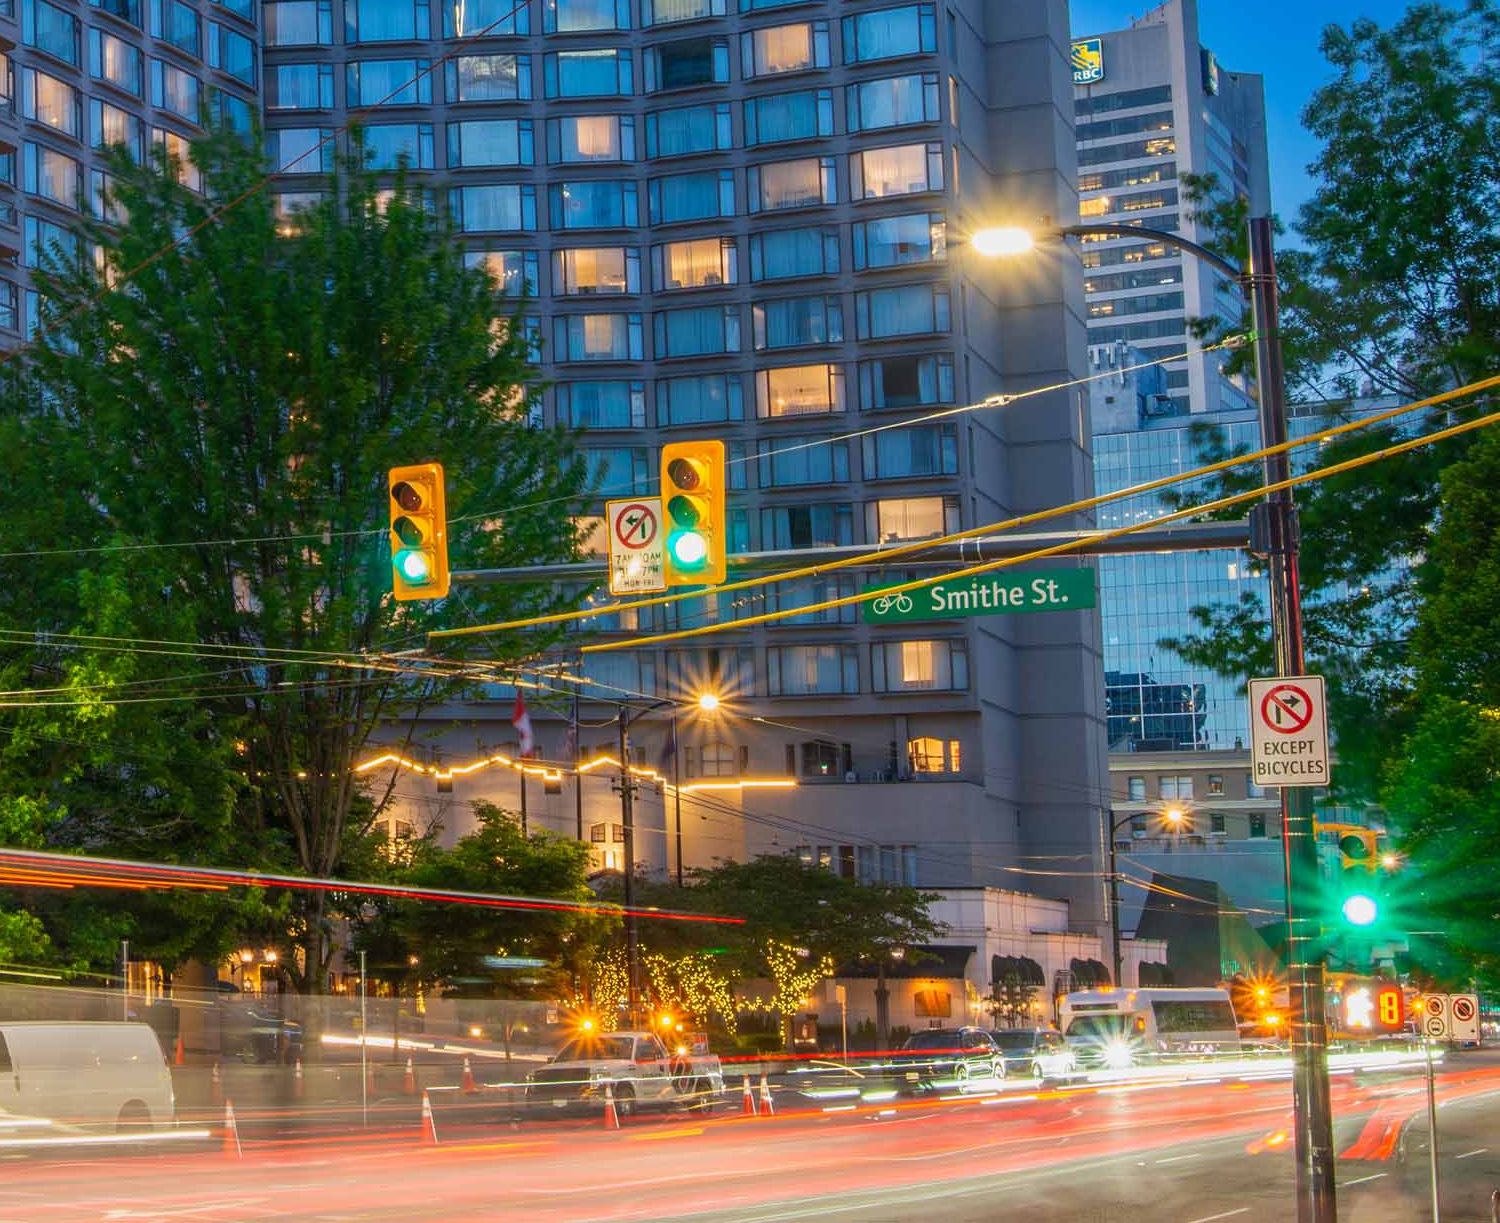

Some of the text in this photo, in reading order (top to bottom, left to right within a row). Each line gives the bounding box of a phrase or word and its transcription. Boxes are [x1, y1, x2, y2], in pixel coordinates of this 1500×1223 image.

[1073, 68, 1100, 81] RBC
[931, 579, 1069, 611] Smithe St.
[1263, 740, 1315, 755] EXCEPT
[1257, 760, 1324, 776] BICYCLES
